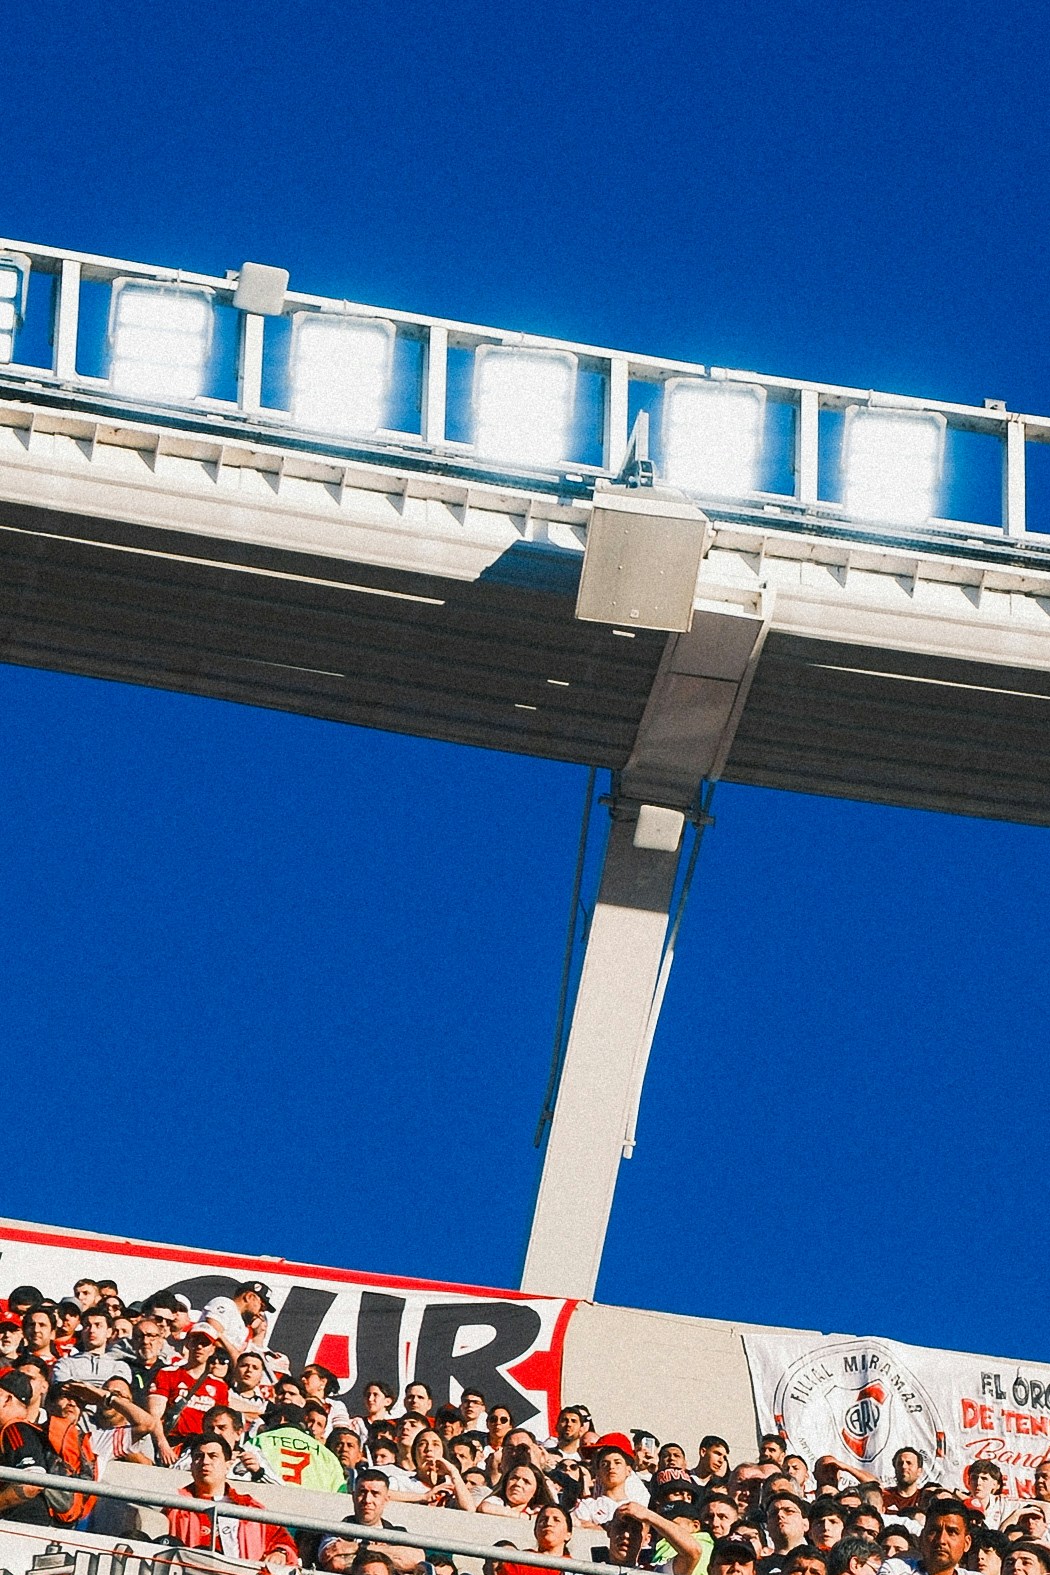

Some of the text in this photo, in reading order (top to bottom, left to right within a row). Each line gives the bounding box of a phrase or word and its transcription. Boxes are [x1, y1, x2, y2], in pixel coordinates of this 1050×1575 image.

[790, 1354, 923, 1414] FILIAL MIRAMAR
[961, 1398, 995, 1430] DE
[280, 1449, 311, 1485] 3
